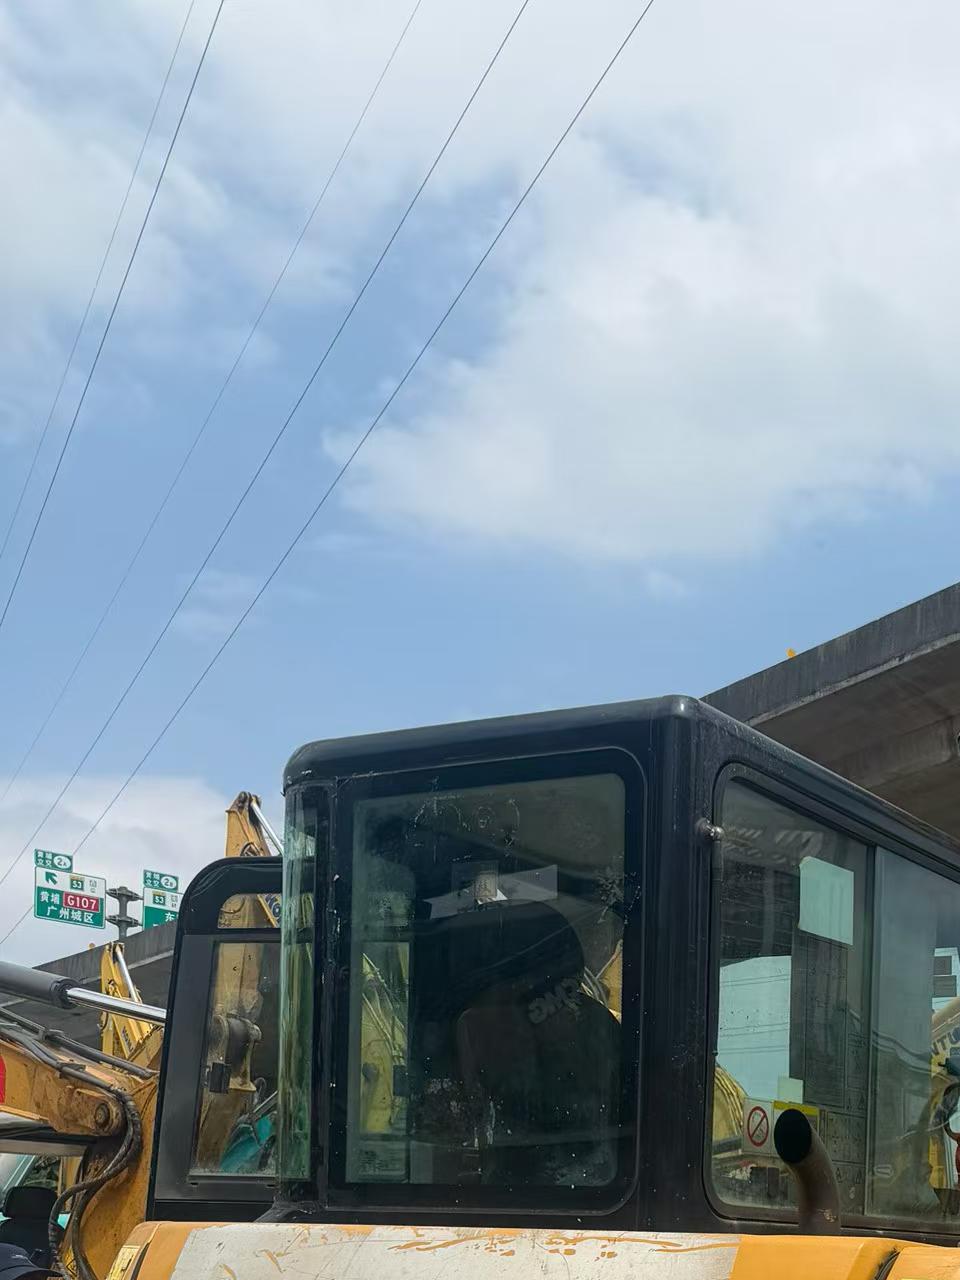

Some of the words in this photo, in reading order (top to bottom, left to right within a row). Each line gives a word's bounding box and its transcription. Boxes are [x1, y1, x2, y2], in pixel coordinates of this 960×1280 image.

[67, 895, 97, 909] G107
[46, 905, 94, 923] 广州城区
